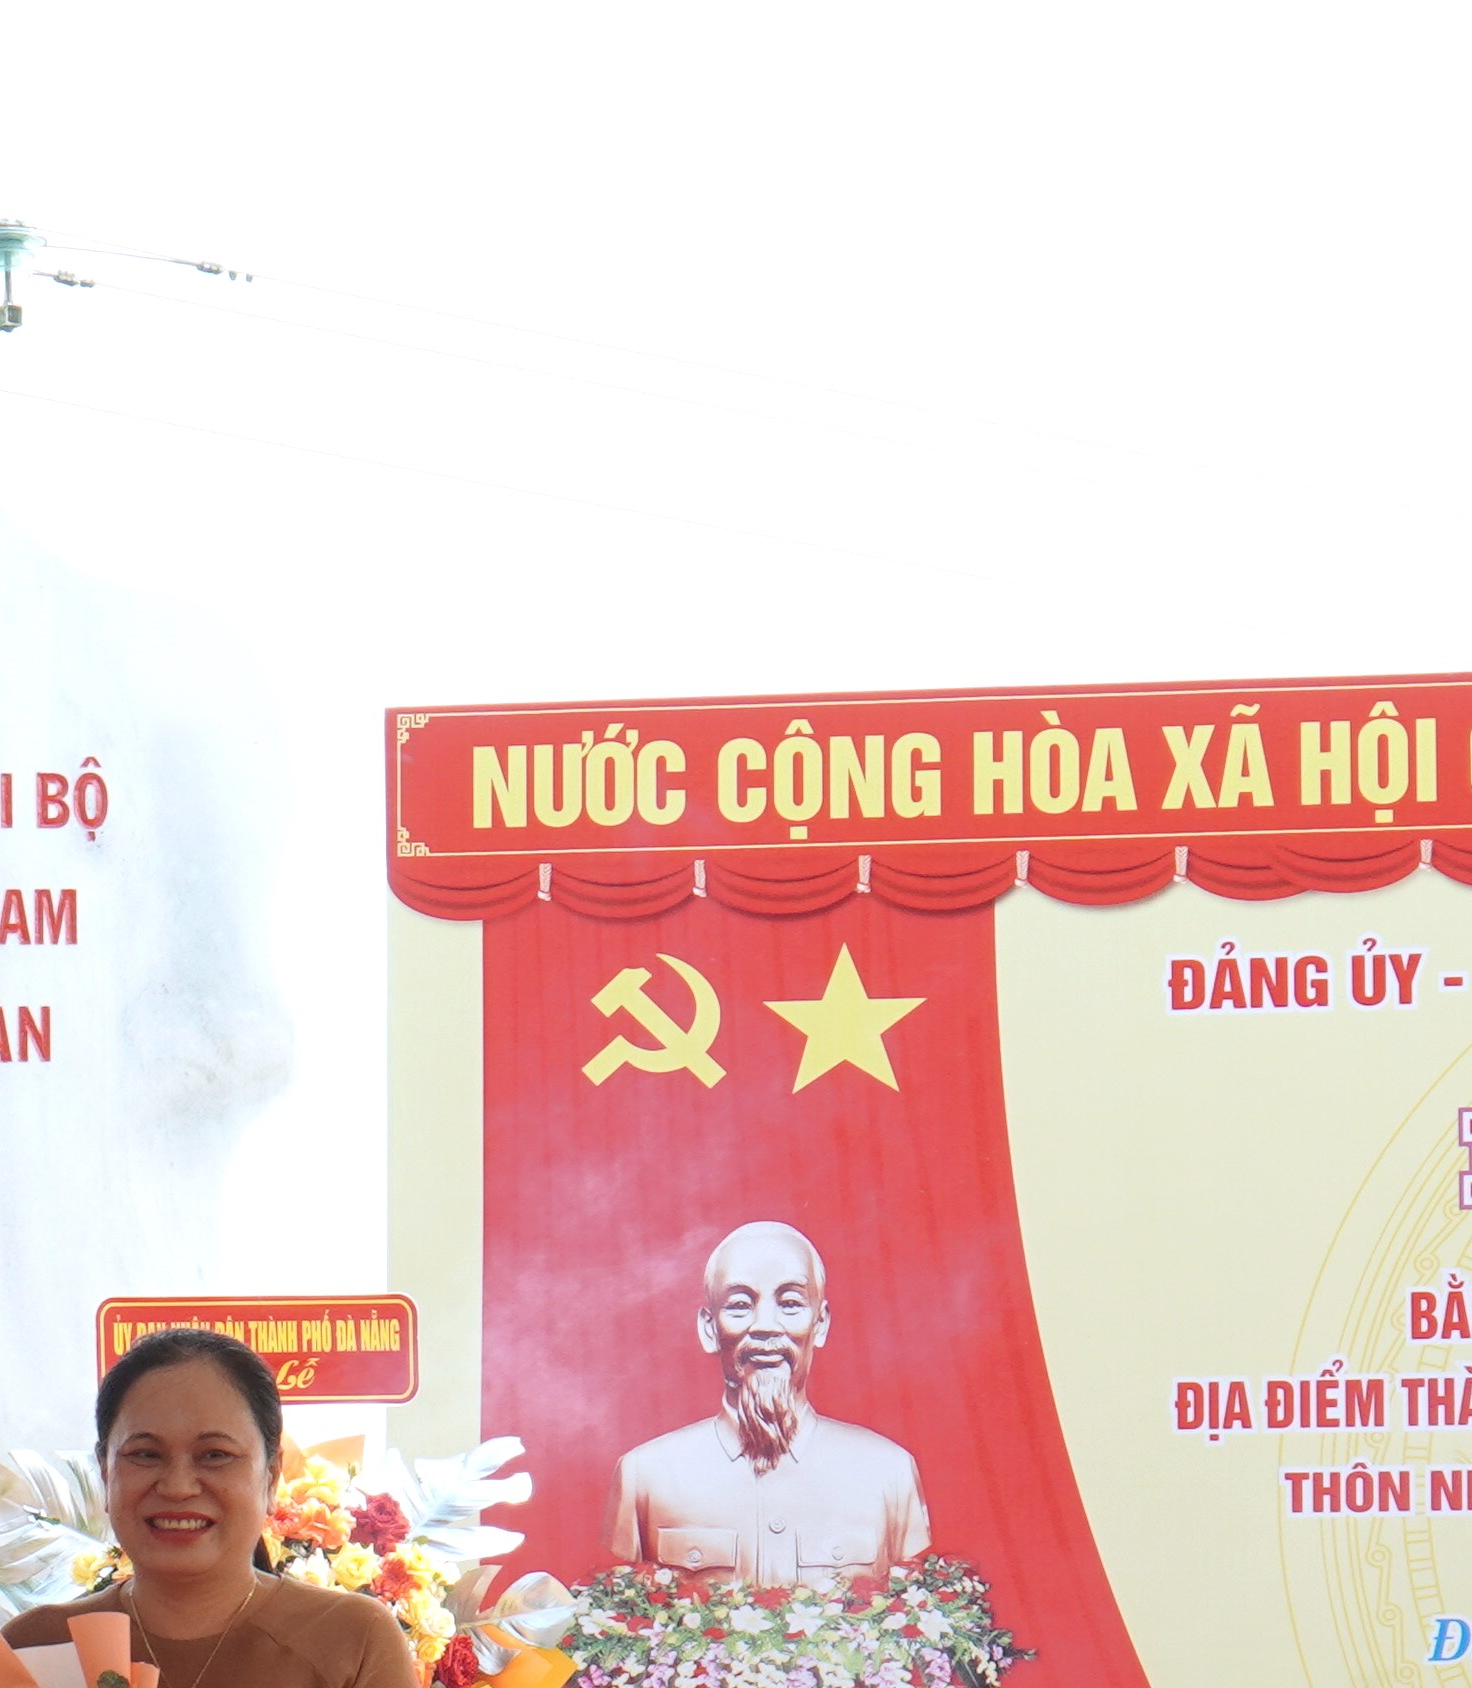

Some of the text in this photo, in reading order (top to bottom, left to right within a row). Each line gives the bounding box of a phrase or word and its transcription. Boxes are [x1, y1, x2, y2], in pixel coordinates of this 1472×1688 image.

[38, 757, 107, 838] BỘ
[473, 723, 686, 828] NƯỚC
[718, 719, 941, 839] CỘNG
[974, 711, 1137, 814] HÒA
[1162, 704, 1274, 809] XÃ
[1301, 701, 1437, 823] HỘI
[1169, 942, 1328, 1009] ĐẢNG
[1352, 938, 1421, 1006] ỦY
[1445, 977, 1463, 986] -
[113, 1314, 132, 1355] ỦY
[248, 1315, 297, 1354] THÀNH
[302, 1309, 332, 1352] PHỐ
[336, 1314, 357, 1351] ĐÀ
[360, 1309, 400, 1352] NẴNG
[276, 1357, 319, 1390] Lễ
[1176, 1382, 1252, 1440] ĐỊA
[1266, 1360, 1384, 1428] ĐIỂM
[1286, 1463, 1410, 1512] THÔN
